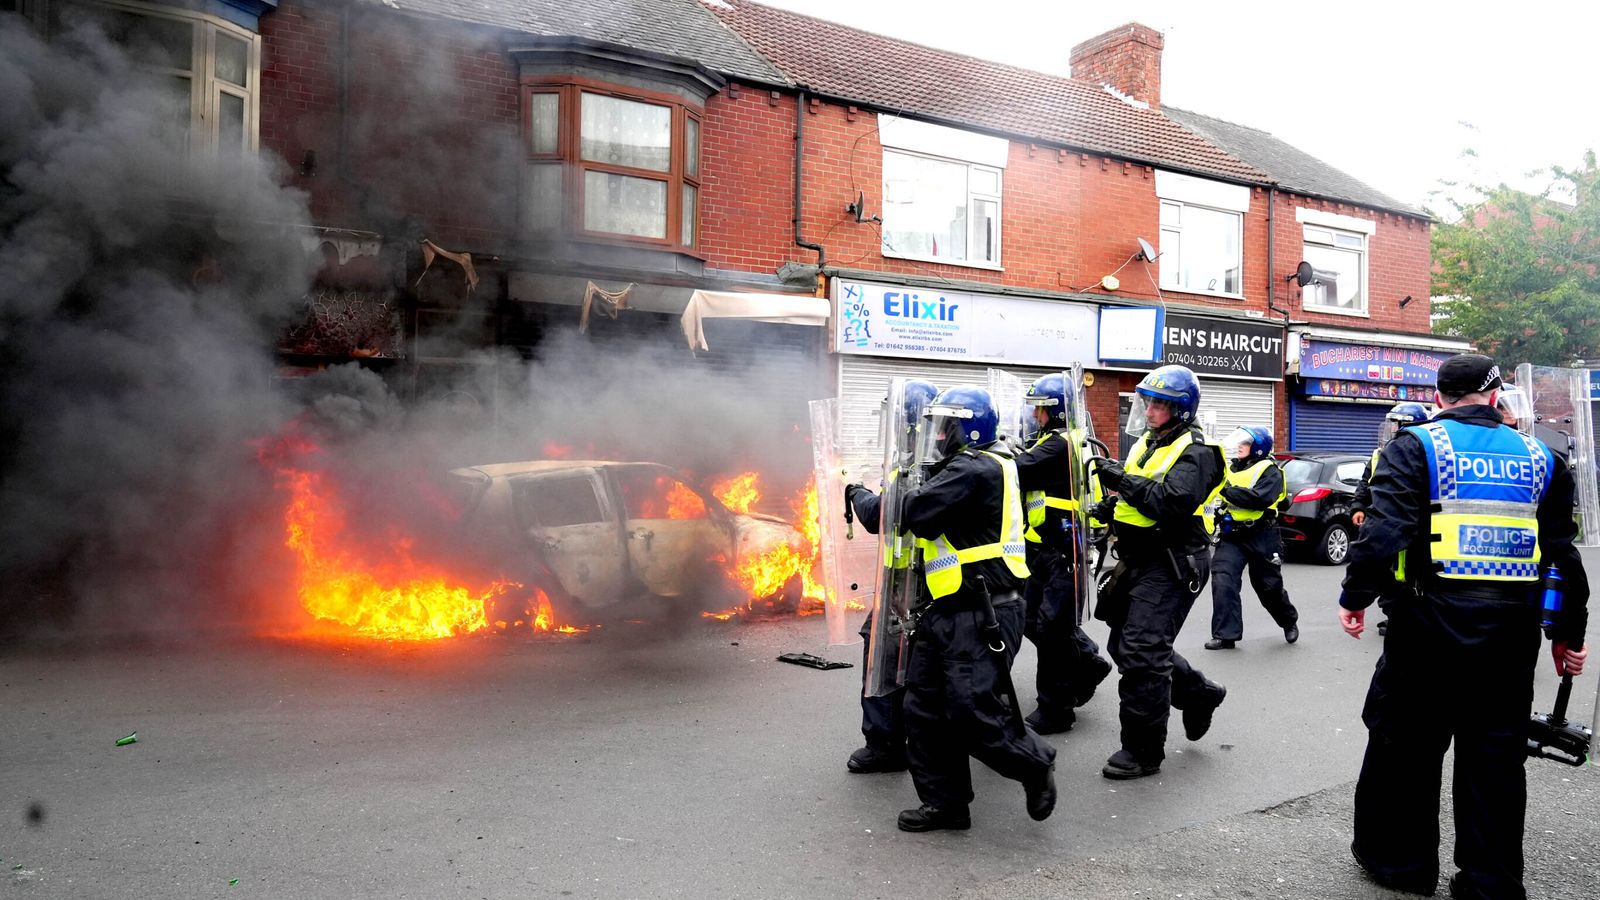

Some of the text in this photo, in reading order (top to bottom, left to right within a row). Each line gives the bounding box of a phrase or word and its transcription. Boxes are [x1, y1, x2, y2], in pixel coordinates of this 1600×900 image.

[883, 292, 959, 321] Elixir
[1211, 331, 1282, 354] HAIRCUT
[1168, 352, 1229, 367] 07404 302265
[1312, 347, 1380, 369] BUCHAREST
[1383, 347, 1407, 363] MINI
[1458, 456, 1531, 482] POLICE
[1466, 527, 1531, 545] POLICE
[1463, 544, 1532, 556] FOOTBALL UNIT
